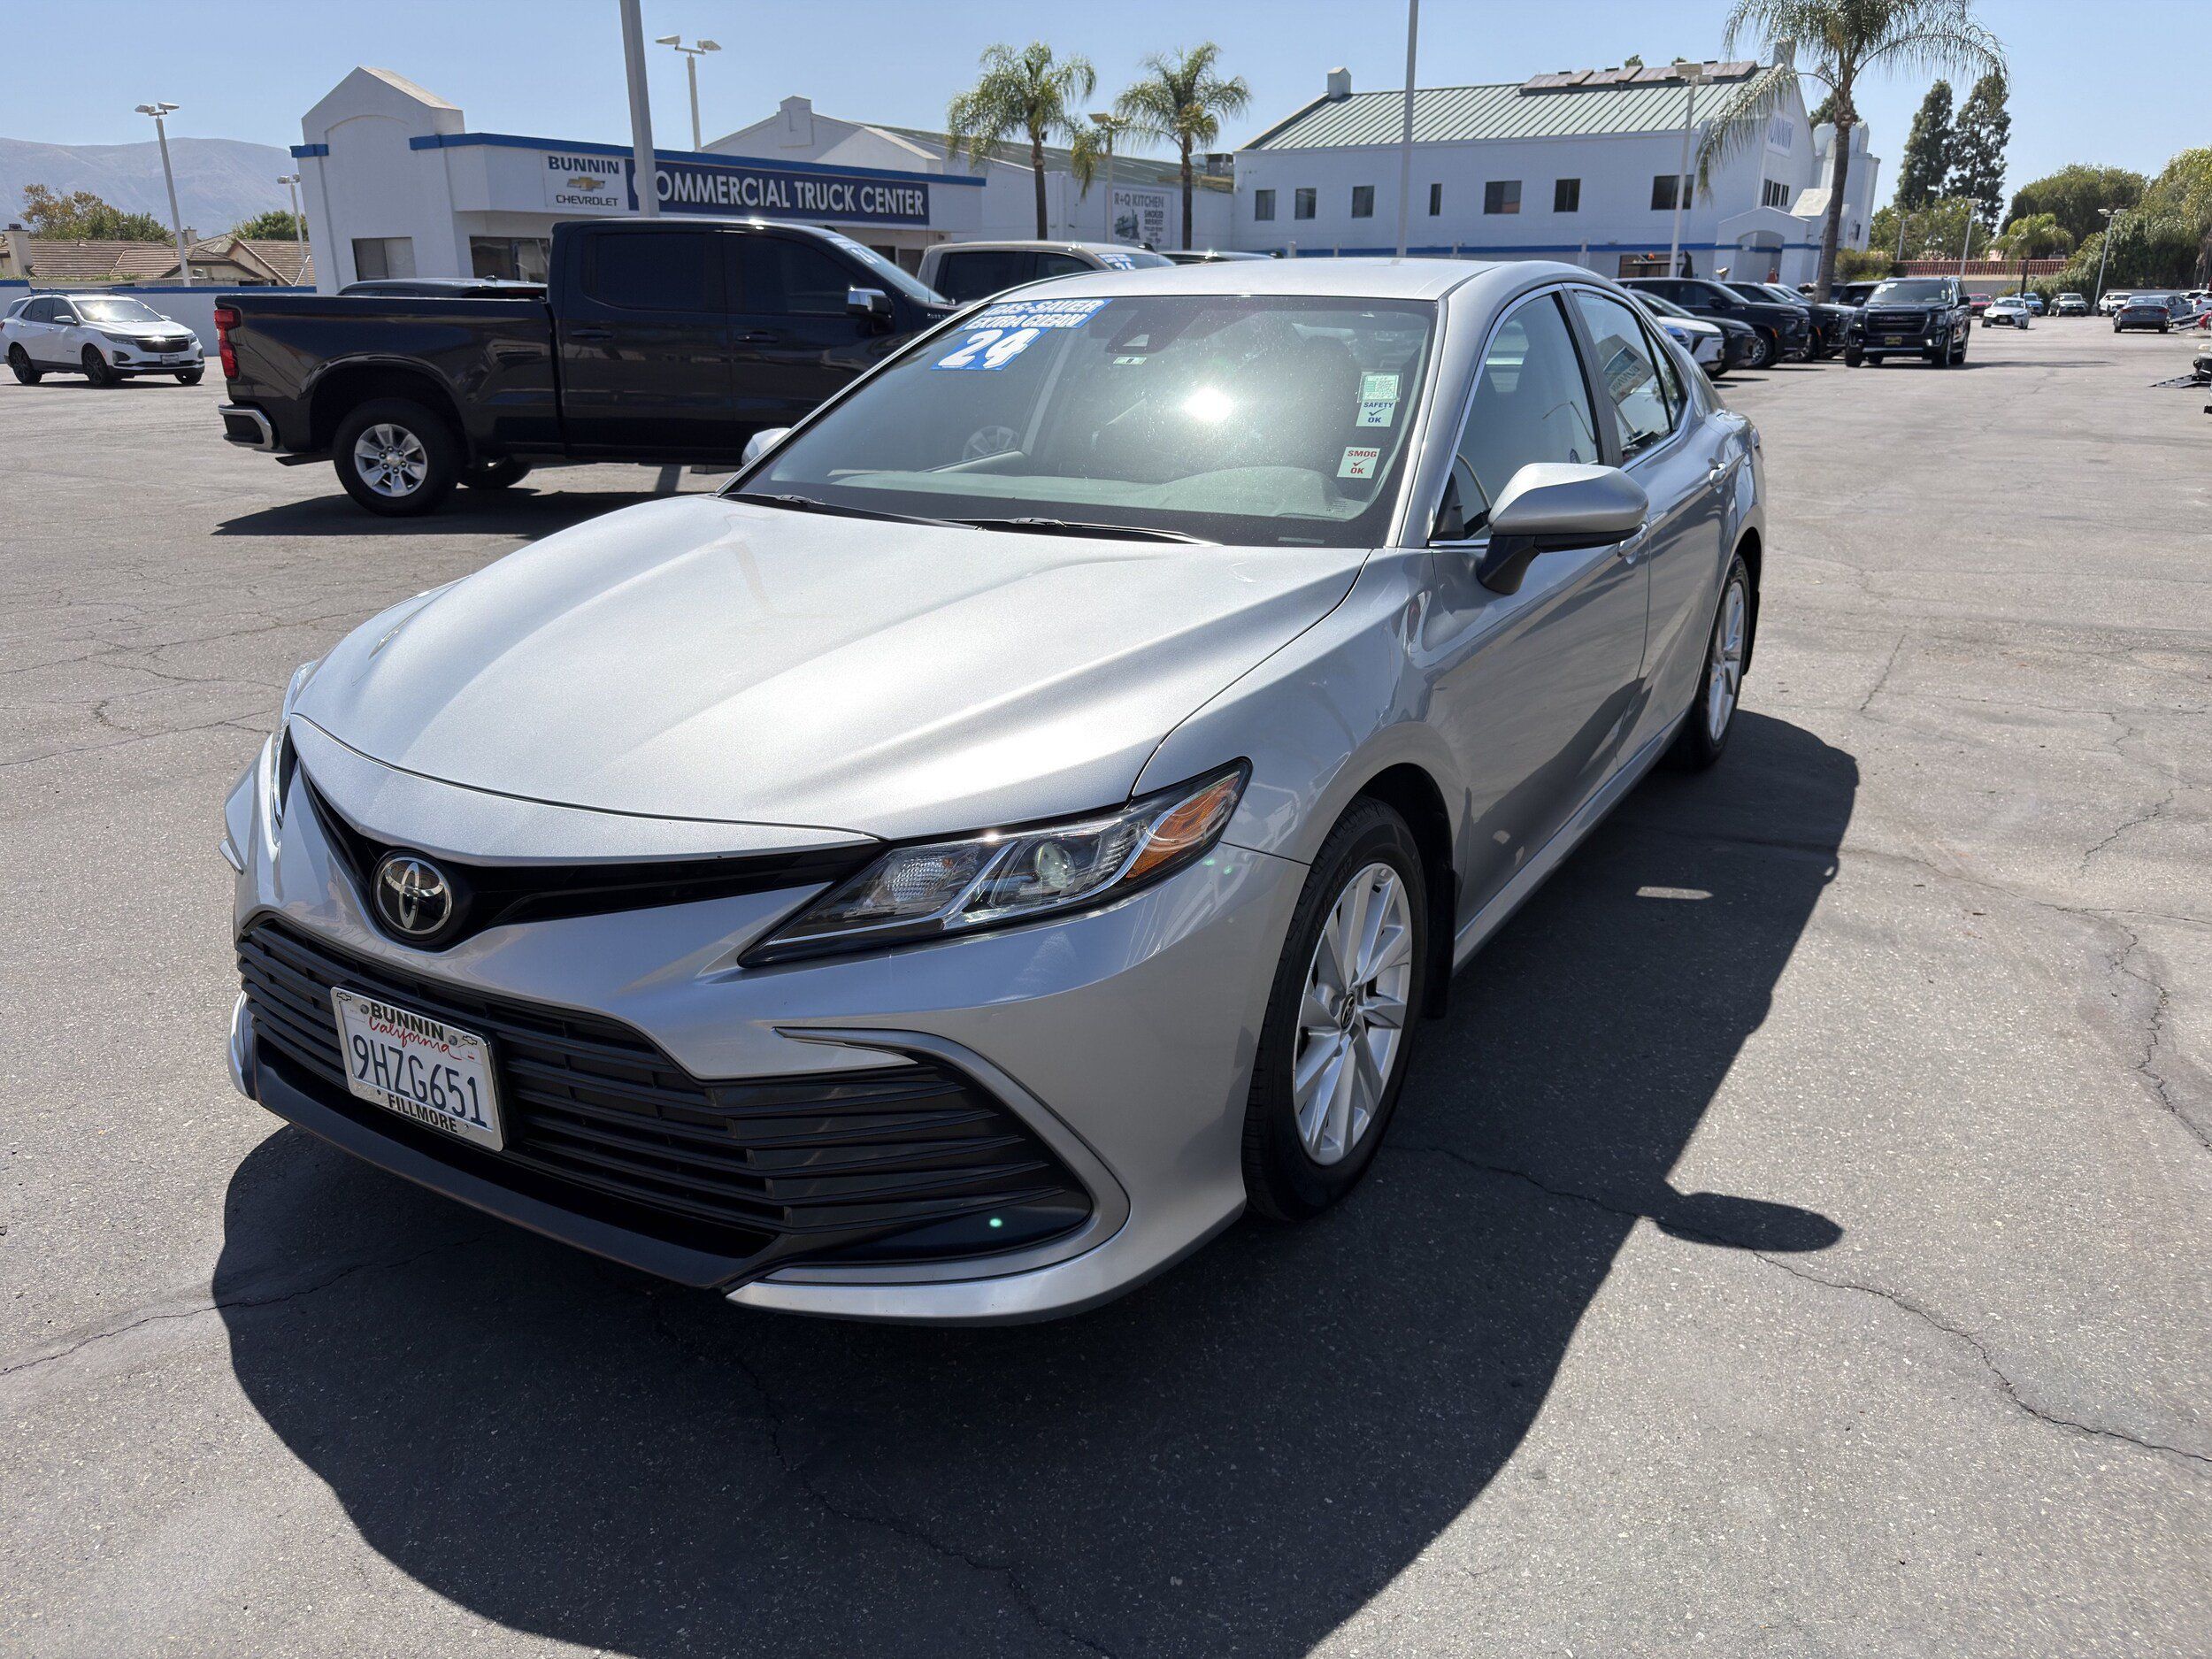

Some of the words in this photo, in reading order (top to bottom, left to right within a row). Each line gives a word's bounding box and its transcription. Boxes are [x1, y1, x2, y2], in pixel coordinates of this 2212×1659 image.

[548, 156, 620, 174] BUNNIN
[556, 195, 618, 206] CHEVROLET
[633, 171, 791, 208] OMMERCIAL
[794, 181, 856, 211] TRUCK
[860, 186, 925, 215] CENTER
[1133, 194, 1164, 208] KITCHEN
[966, 314, 1029, 328] EXTRA
[1021, 314, 1088, 327] CLEAN
[938, 327, 1041, 368] 24
[369, 1017, 462, 1061] California
[371, 1002, 444, 1041] BUNNIN
[352, 1034, 488, 1128] 9HZG651
[387, 1093, 459, 1133] FILLMORE
